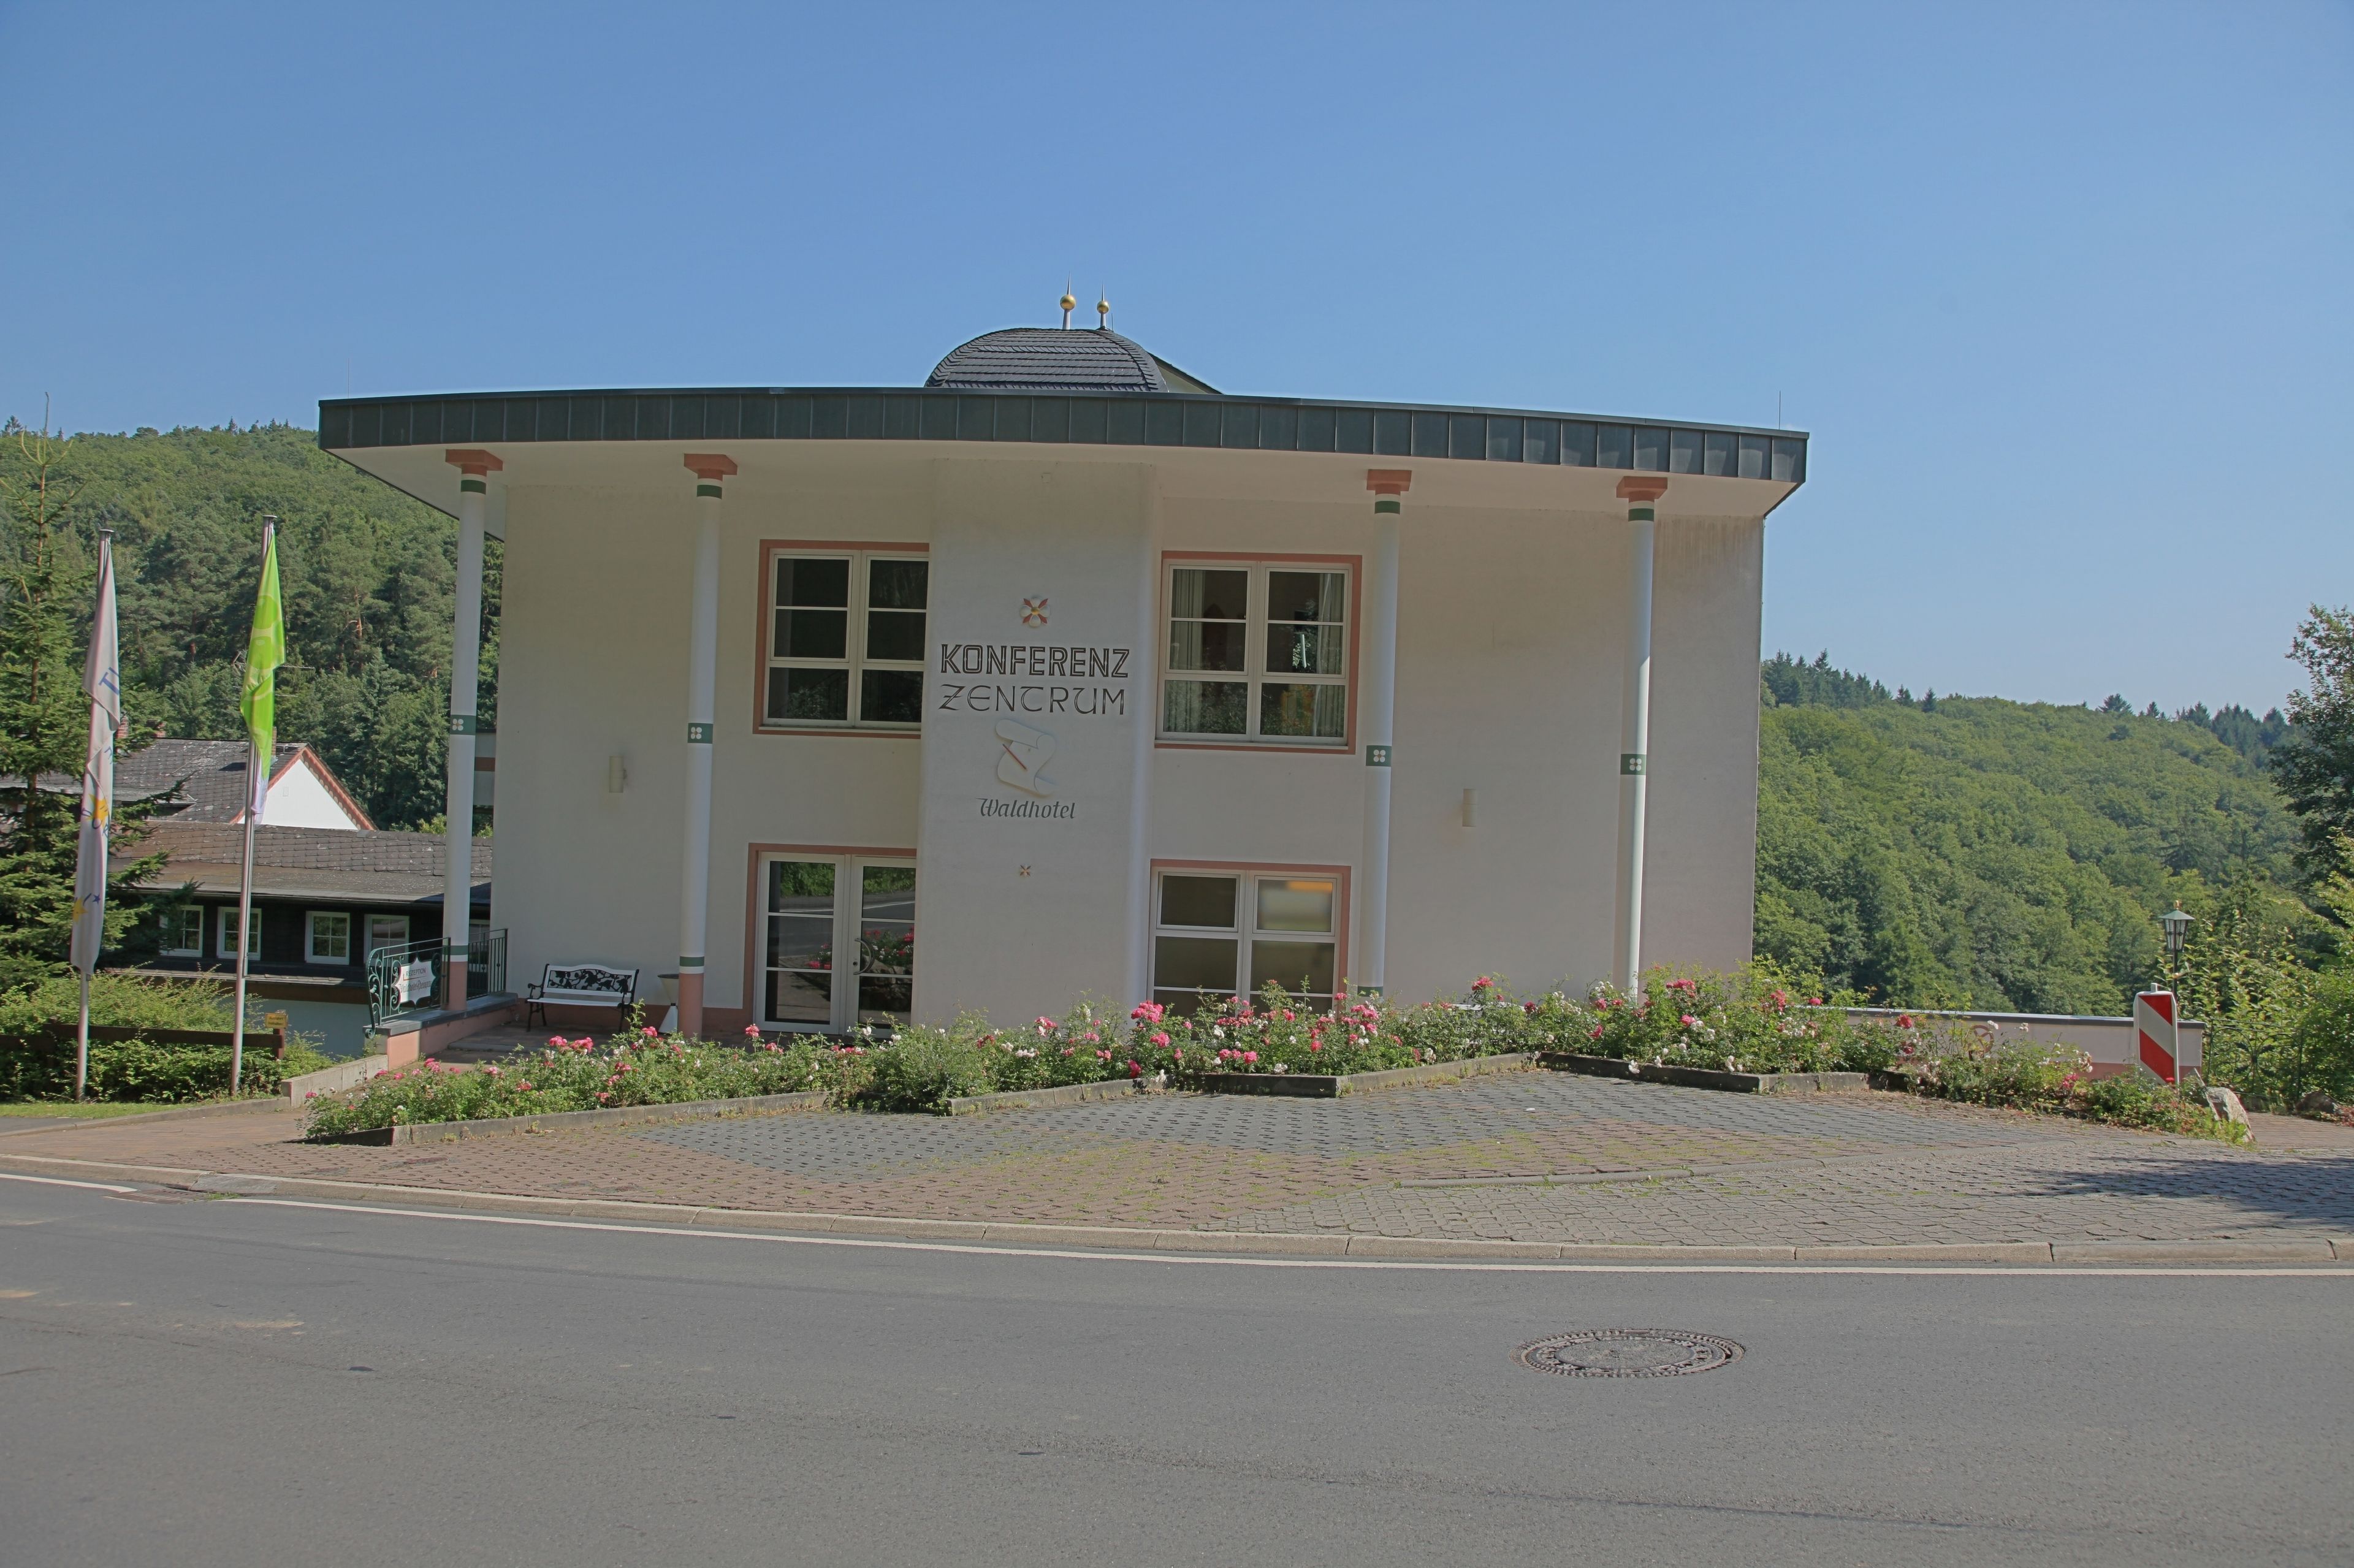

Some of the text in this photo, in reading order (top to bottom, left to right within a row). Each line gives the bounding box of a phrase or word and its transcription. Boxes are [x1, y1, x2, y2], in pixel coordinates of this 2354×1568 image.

[940, 644, 1130, 678] KONFERENZ
[938, 683, 1125, 715] ZENTRUM
[976, 797, 1075, 819] Waldhotel
[405, 967, 426, 976] REZEPTION
